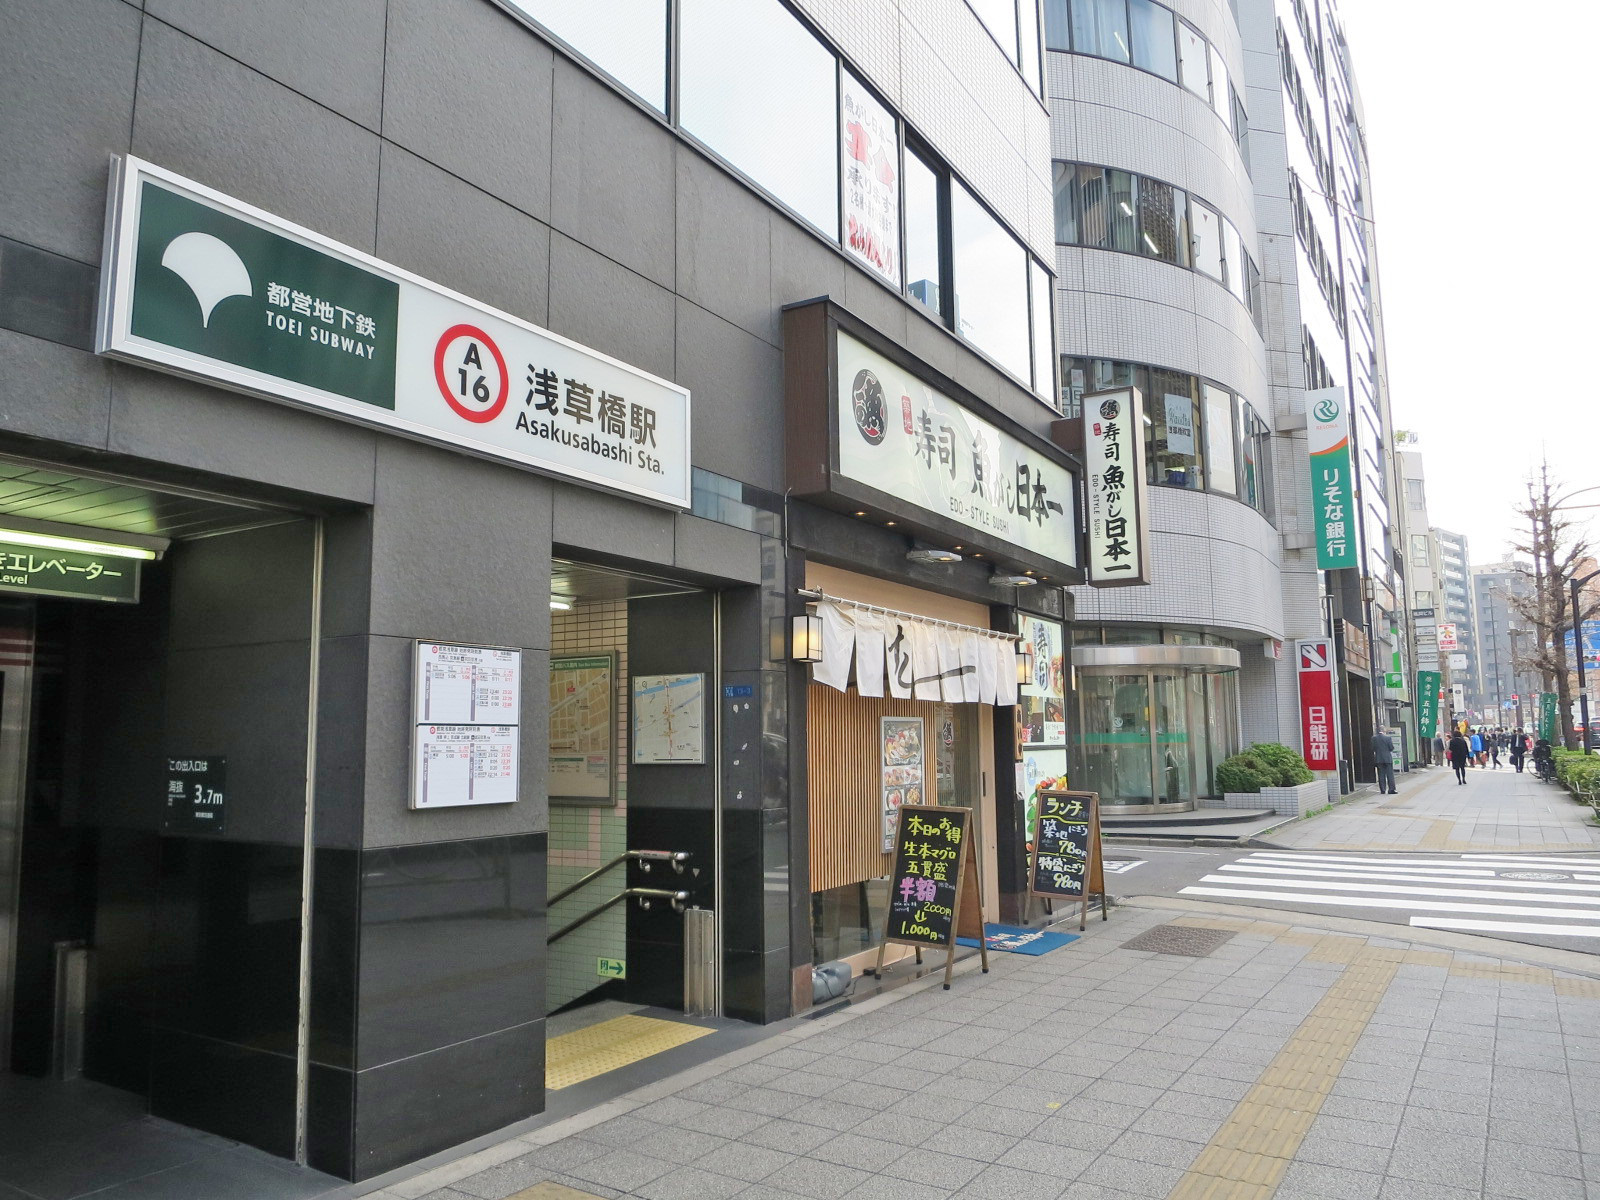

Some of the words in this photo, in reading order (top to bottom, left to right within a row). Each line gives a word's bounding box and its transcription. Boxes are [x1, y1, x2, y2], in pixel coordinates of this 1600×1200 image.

[267, 281, 376, 339] 都営地下鉄
[266, 310, 302, 336] TOEI
[310, 326, 375, 360] SUBWAY
[463, 342, 482, 370] A
[458, 367, 490, 403] 16
[525, 363, 657, 448] 浅草橋駅
[515, 411, 632, 465] Asakusabashi
[638, 450, 664, 475] Sta.
[1322, 468, 1346, 558] りそな銀行
[0, 574, 28, 584] evel
[1308, 706, 1328, 760] 日能研
[169, 760, 208, 772] この出入口は
[194, 784, 223, 804] 3.7m
[1046, 798, 1084, 816] ランチ
[908, 815, 962, 844] 本日のお得
[904, 841, 956, 860] 生本マグロ
[906, 860, 948, 881] 五貫盛
[1053, 872, 1082, 891] 980円
[900, 876, 936, 902] 半額
